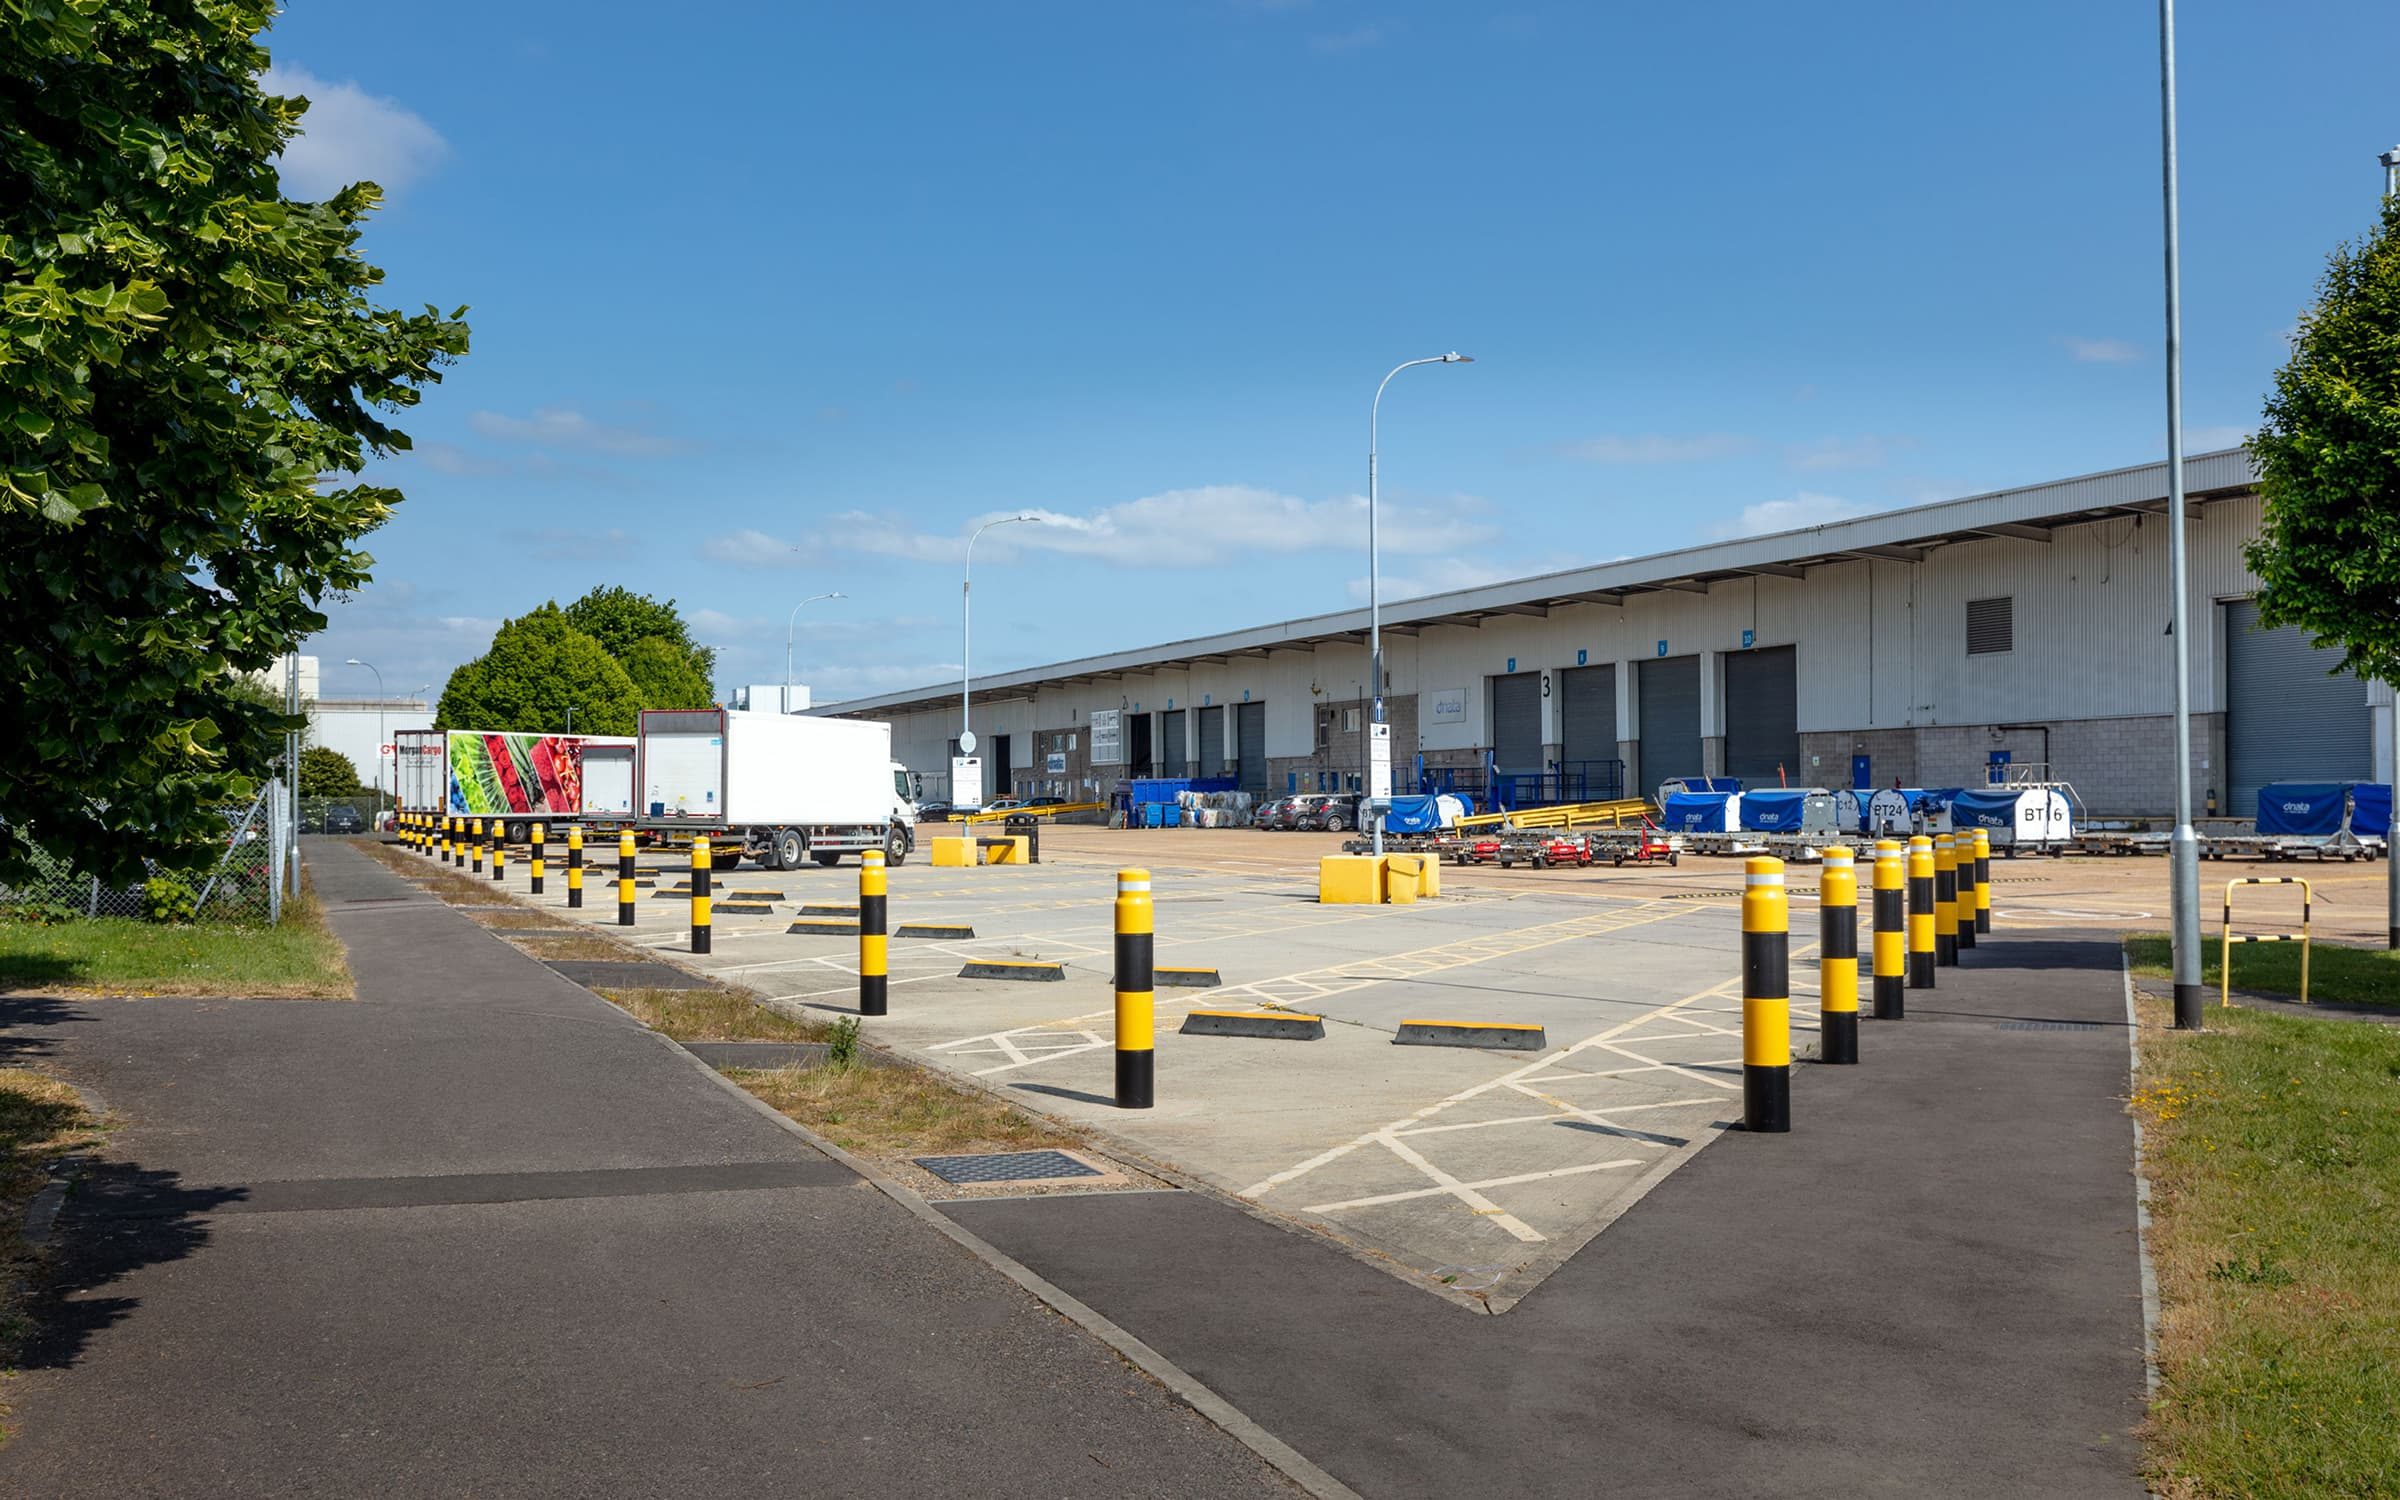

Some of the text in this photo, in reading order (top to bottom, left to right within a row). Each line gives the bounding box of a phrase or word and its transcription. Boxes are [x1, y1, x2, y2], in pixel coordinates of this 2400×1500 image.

[1542, 675, 1551, 698] 3
[1874, 804, 1903, 817] BT24
[2282, 801, 2310, 811] dnata
[1978, 813, 2004, 826] dnata
